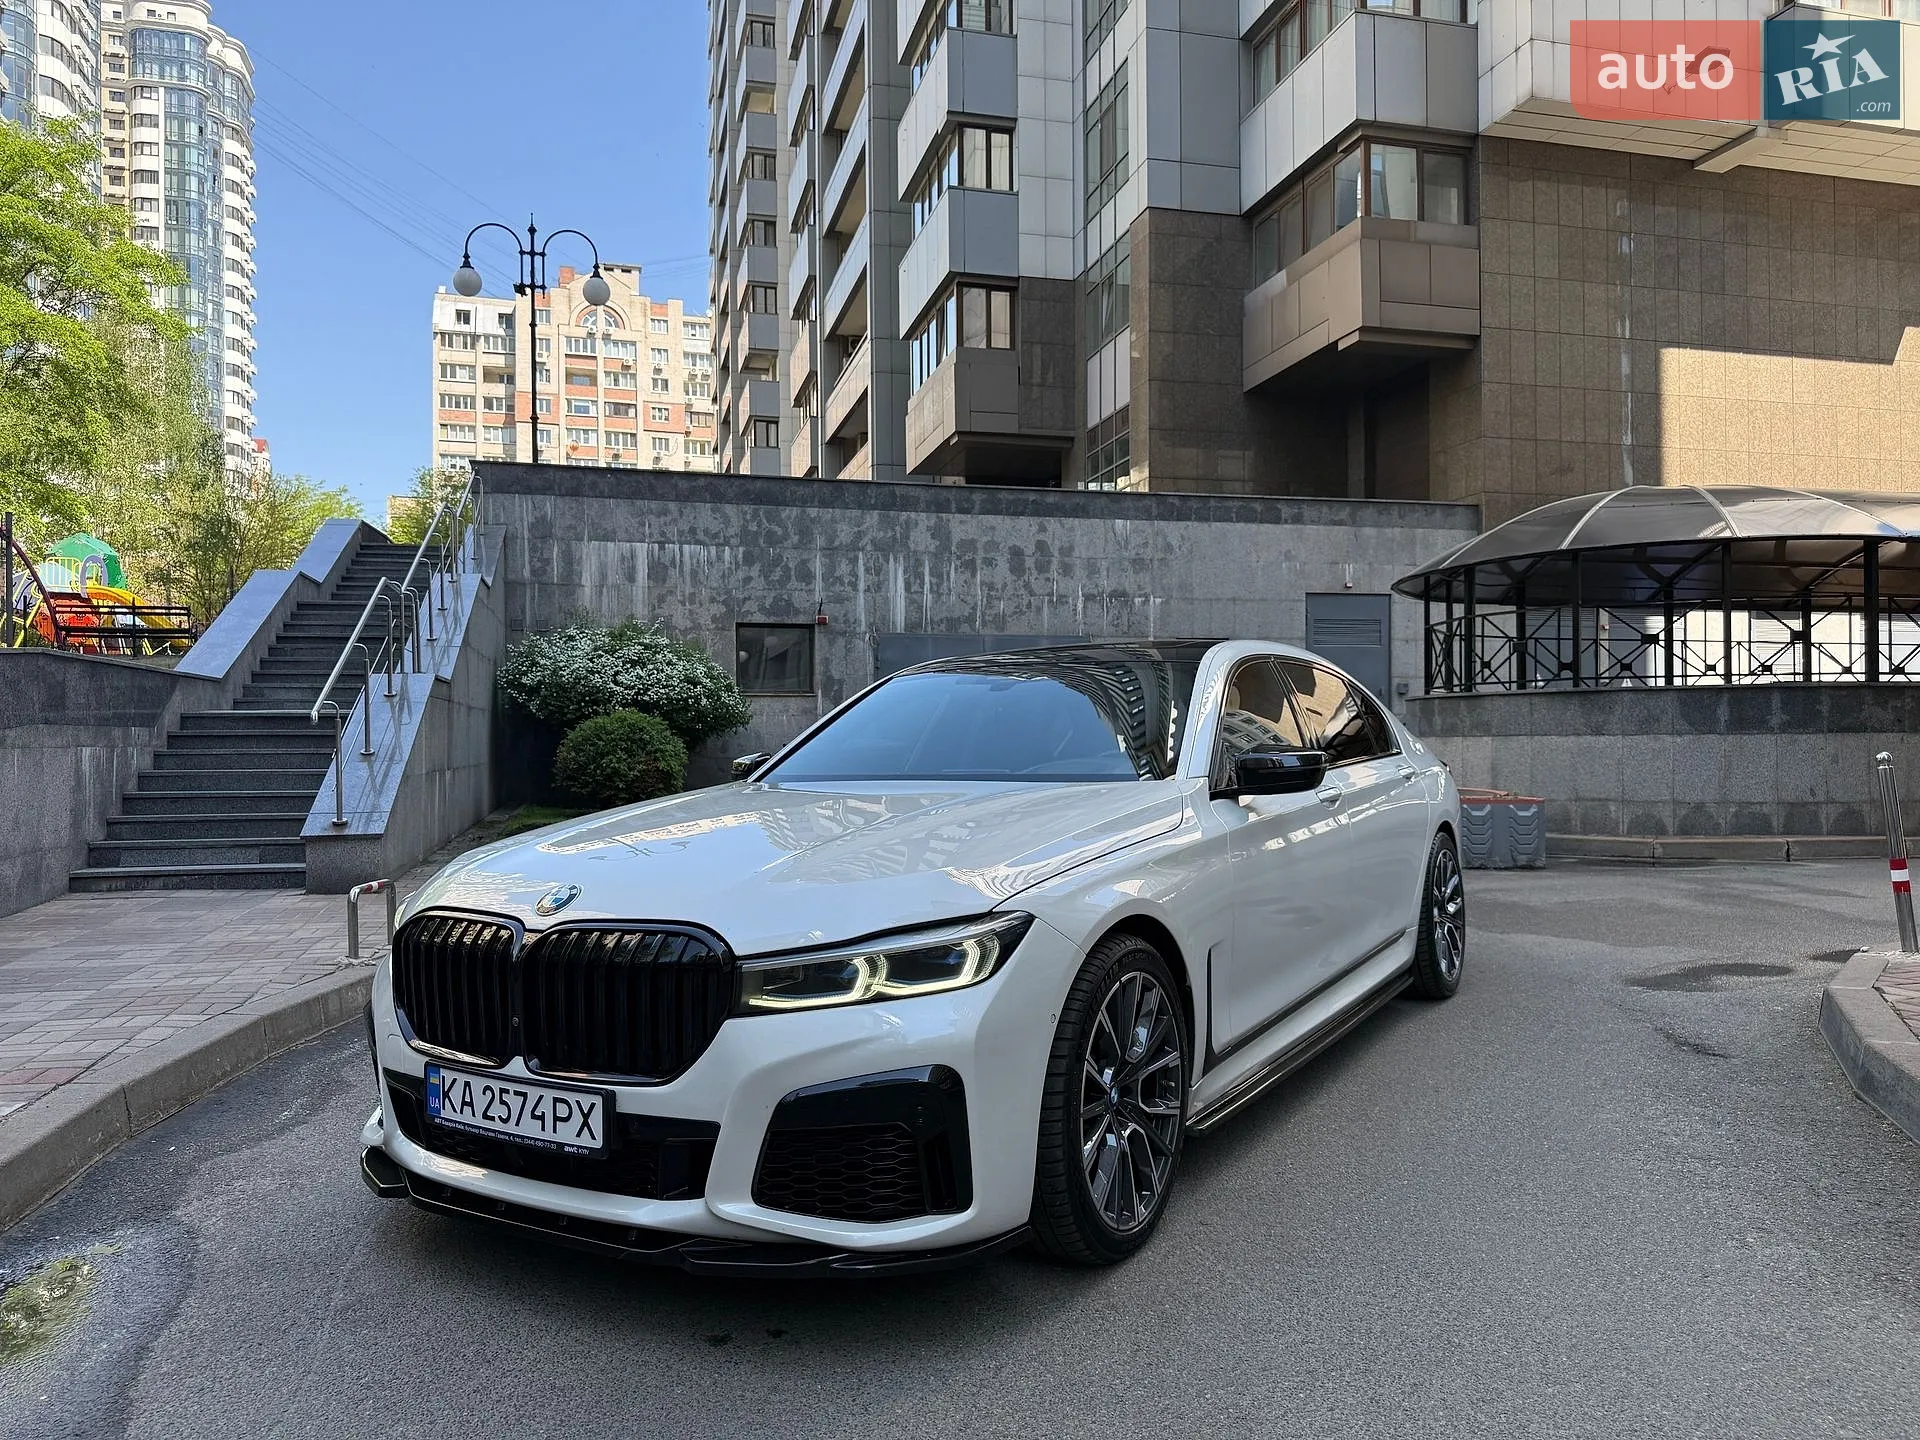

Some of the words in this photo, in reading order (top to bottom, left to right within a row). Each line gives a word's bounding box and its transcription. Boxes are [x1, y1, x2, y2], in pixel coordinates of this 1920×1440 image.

[429, 1096, 440, 1109] UA
[441, 1074, 476, 1118] KA
[481, 1084, 546, 1132] 2574
[552, 1096, 597, 1141] PX
